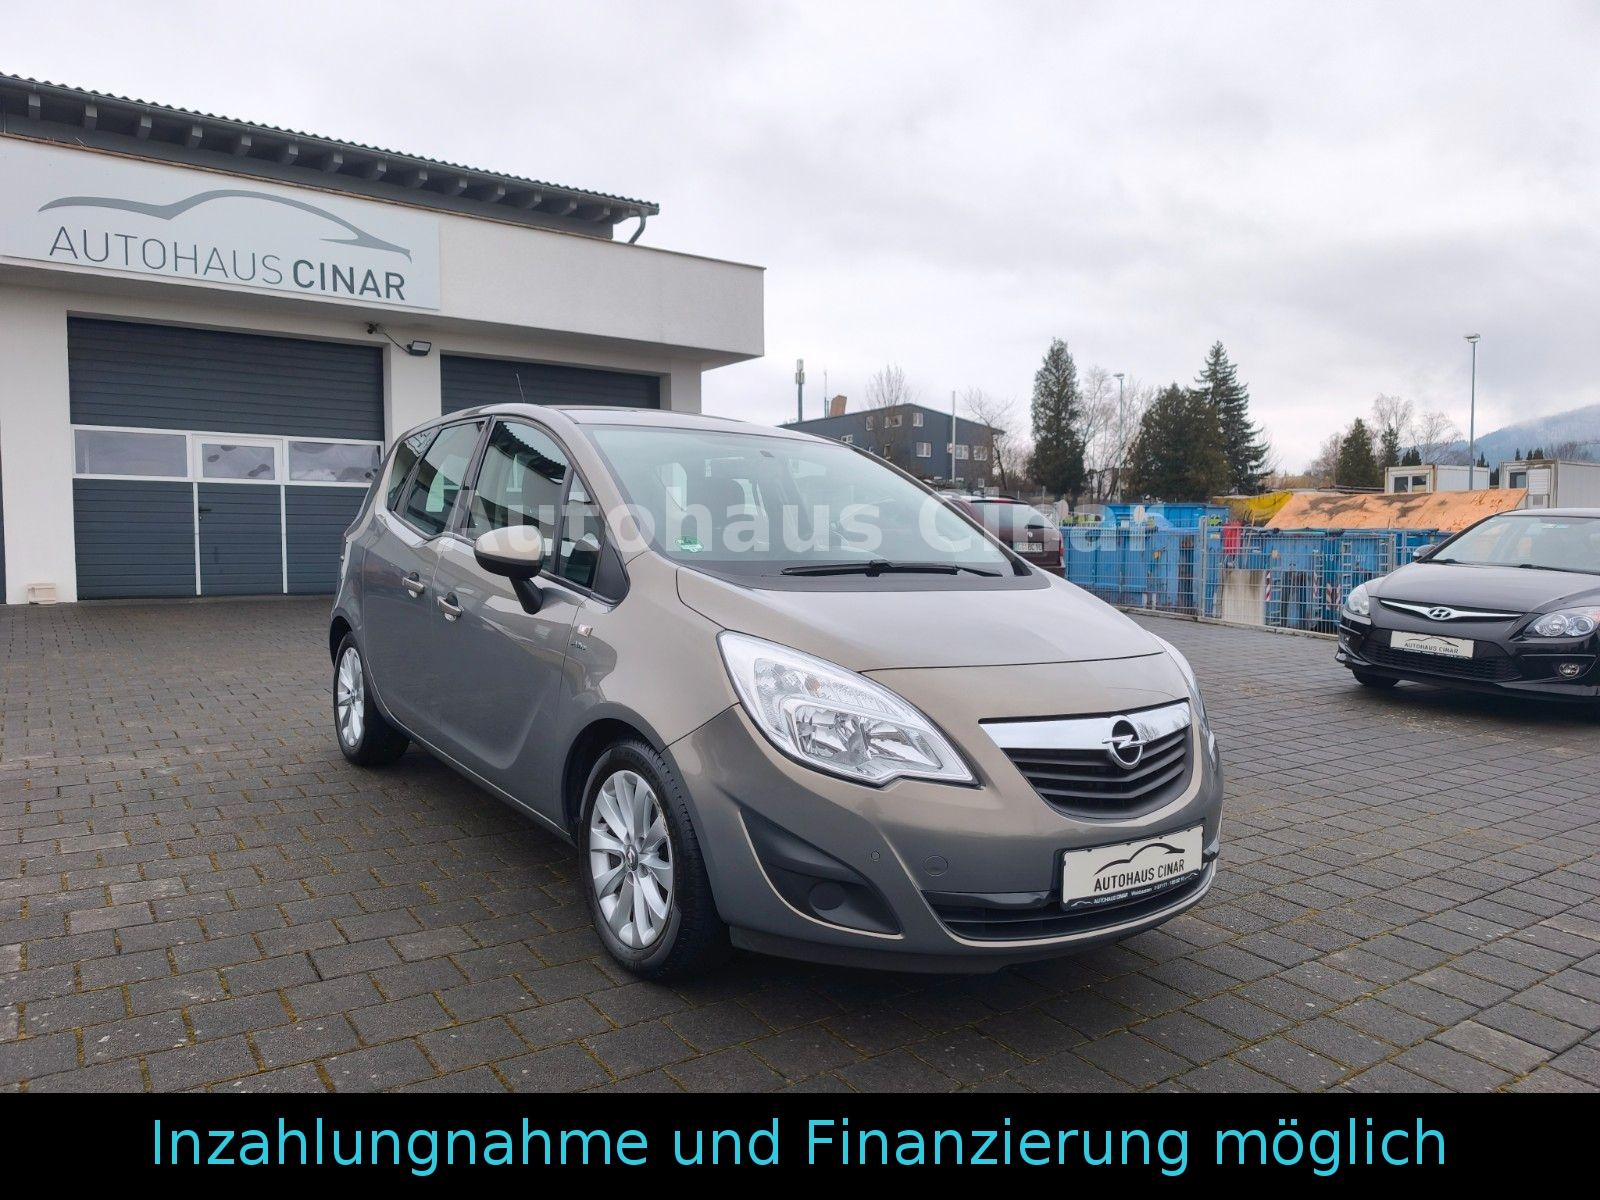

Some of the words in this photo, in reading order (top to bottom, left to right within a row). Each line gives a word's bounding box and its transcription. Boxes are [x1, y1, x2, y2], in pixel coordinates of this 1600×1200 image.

[48, 225, 284, 285] AUTOHAUS
[292, 258, 406, 301] CINAR
[1404, 642, 1437, 652] AUTOHAUS
[1438, 645, 1459, 654] CINAR
[1093, 867, 1155, 892] AUTOHAUS
[1157, 858, 1185, 878] CINAR
